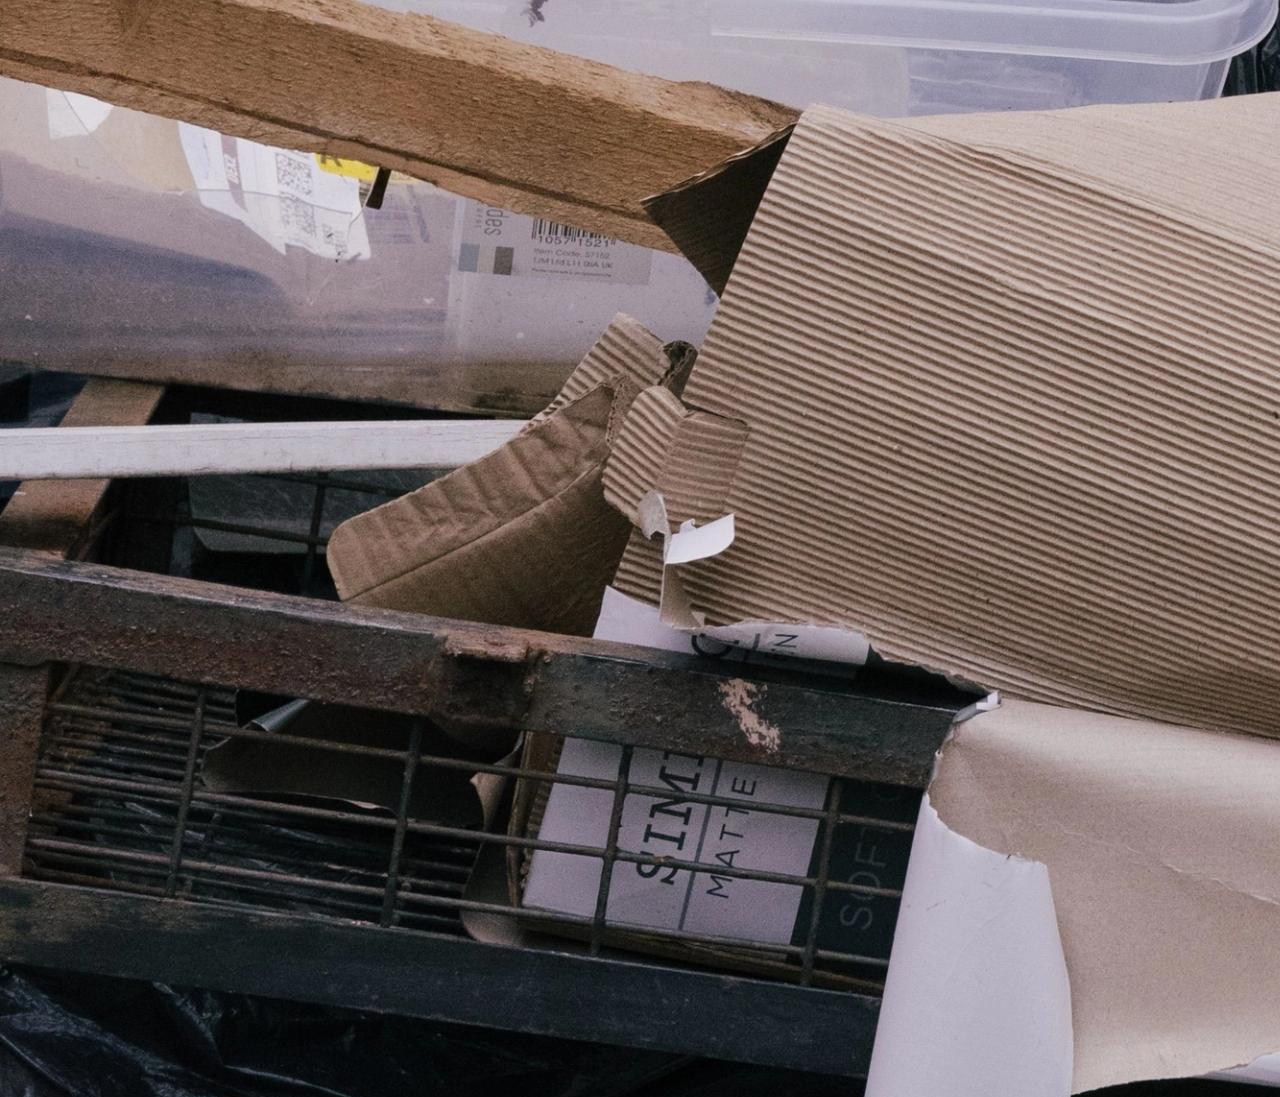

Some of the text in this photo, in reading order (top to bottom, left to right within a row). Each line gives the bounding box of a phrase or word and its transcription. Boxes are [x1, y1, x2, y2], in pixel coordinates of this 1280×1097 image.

[538, 235, 609, 248] 1057 1521
[706, 776, 756, 898] MATTE
